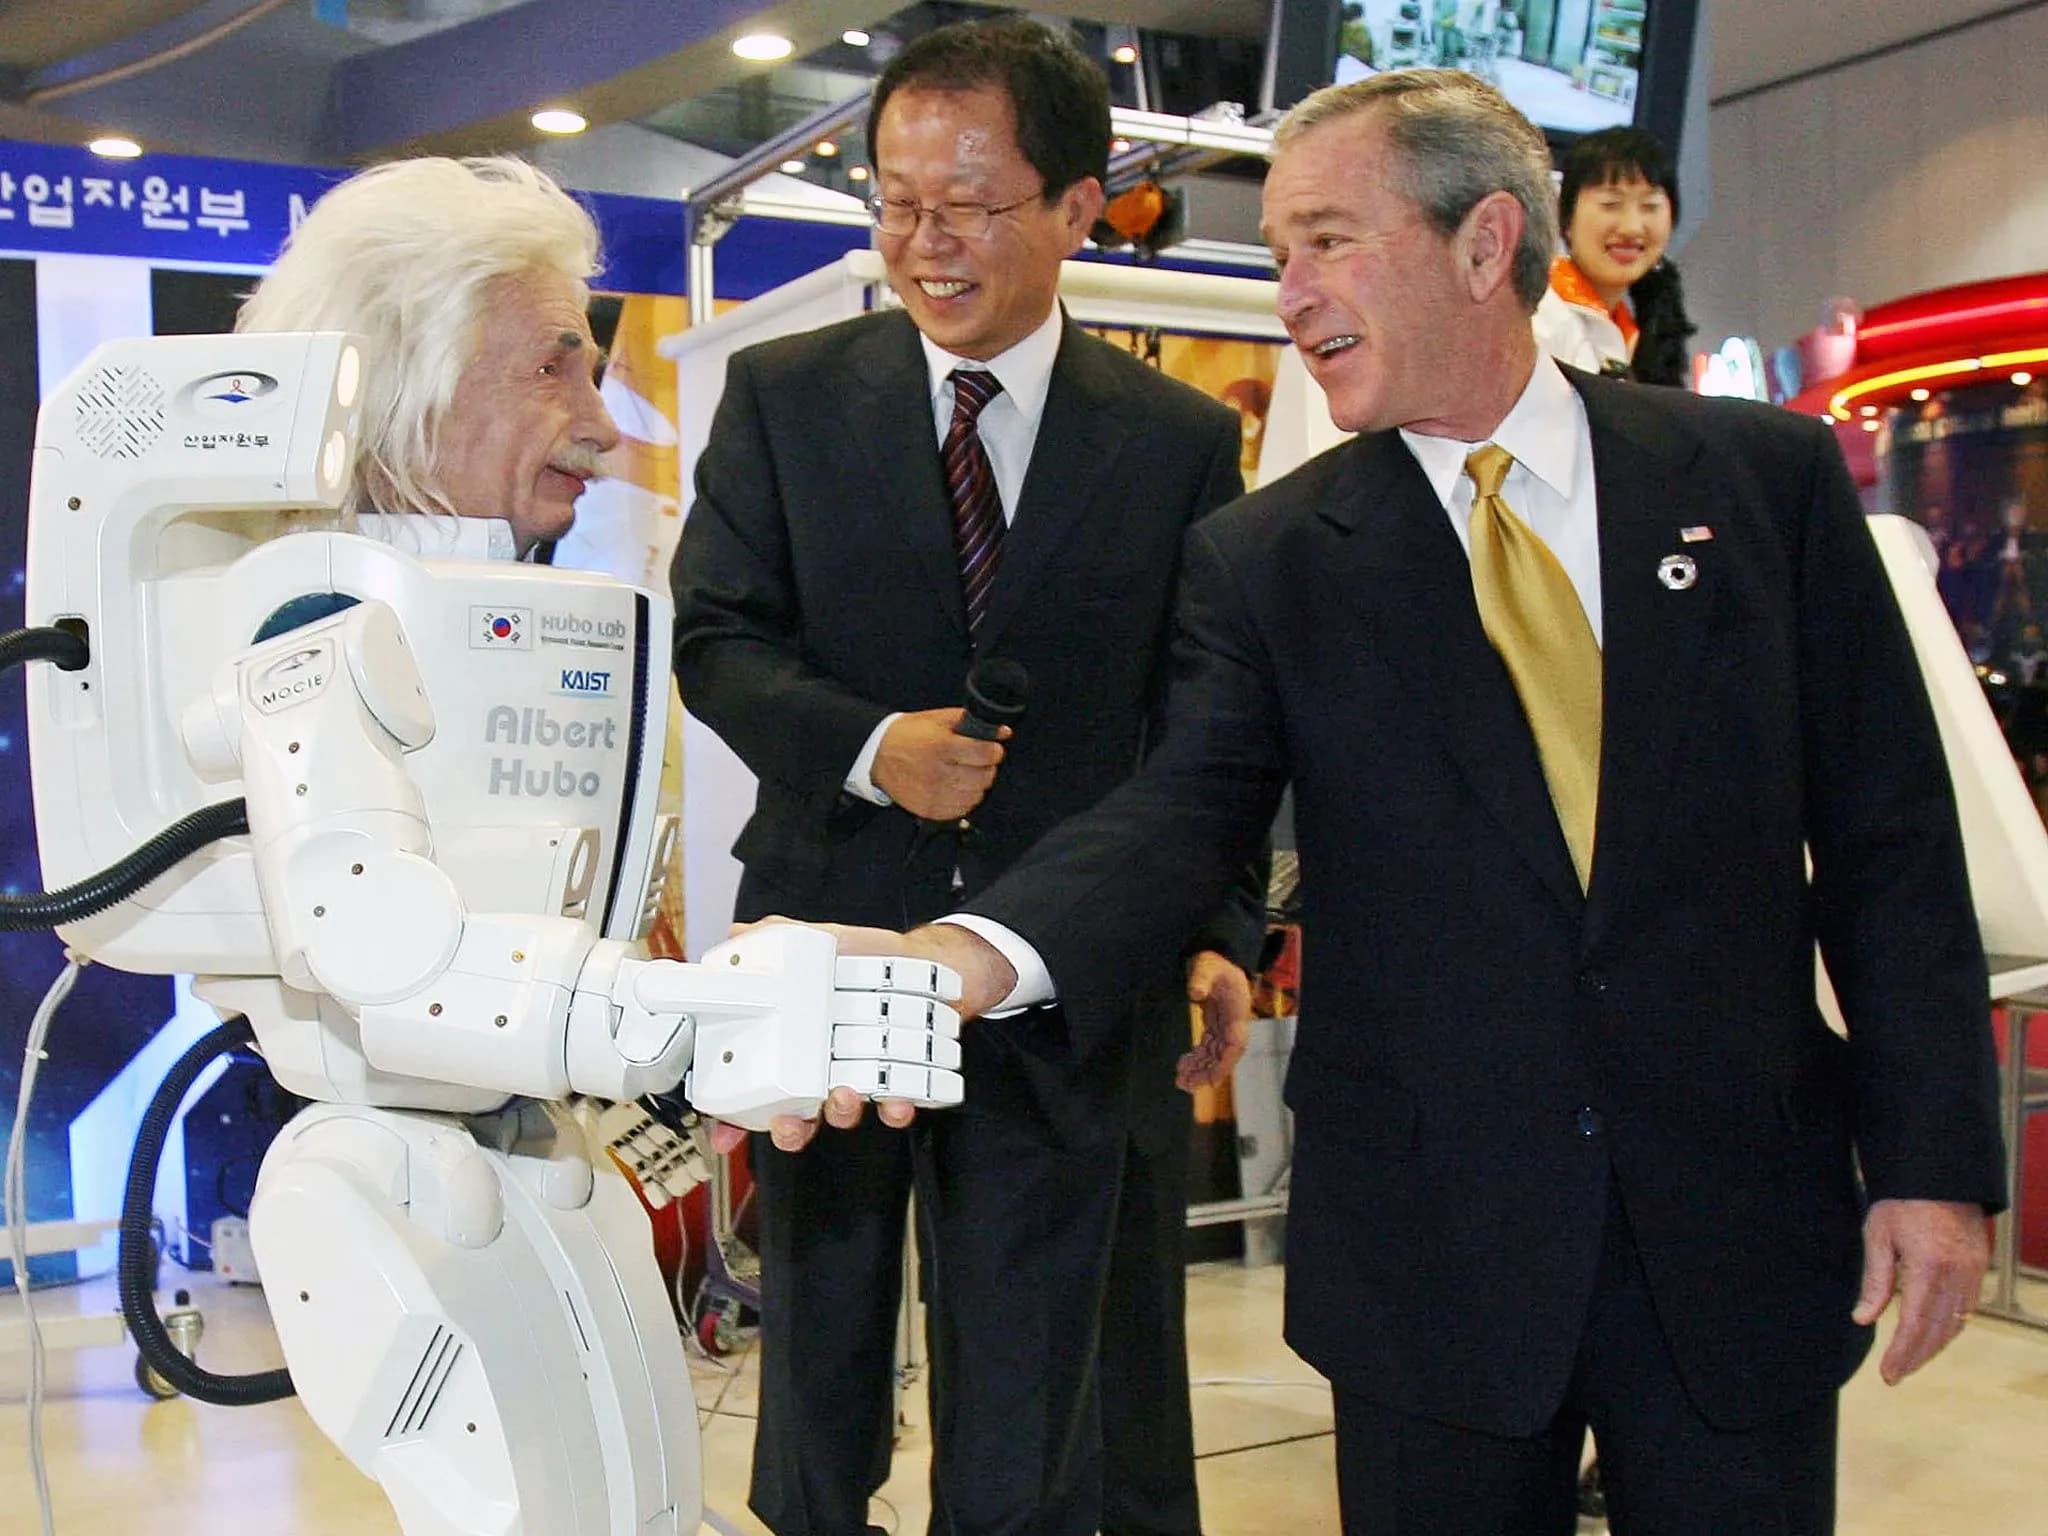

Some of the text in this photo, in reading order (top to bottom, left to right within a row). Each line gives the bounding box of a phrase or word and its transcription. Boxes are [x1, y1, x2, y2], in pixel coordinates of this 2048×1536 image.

[184, 433, 269, 449] 산업자원부
[541, 613, 593, 634] Hubo
[262, 674, 322, 705] MOCIE
[561, 669, 610, 691] KAIST
[485, 704, 616, 749] Albert
[488, 757, 600, 797] Hubo
